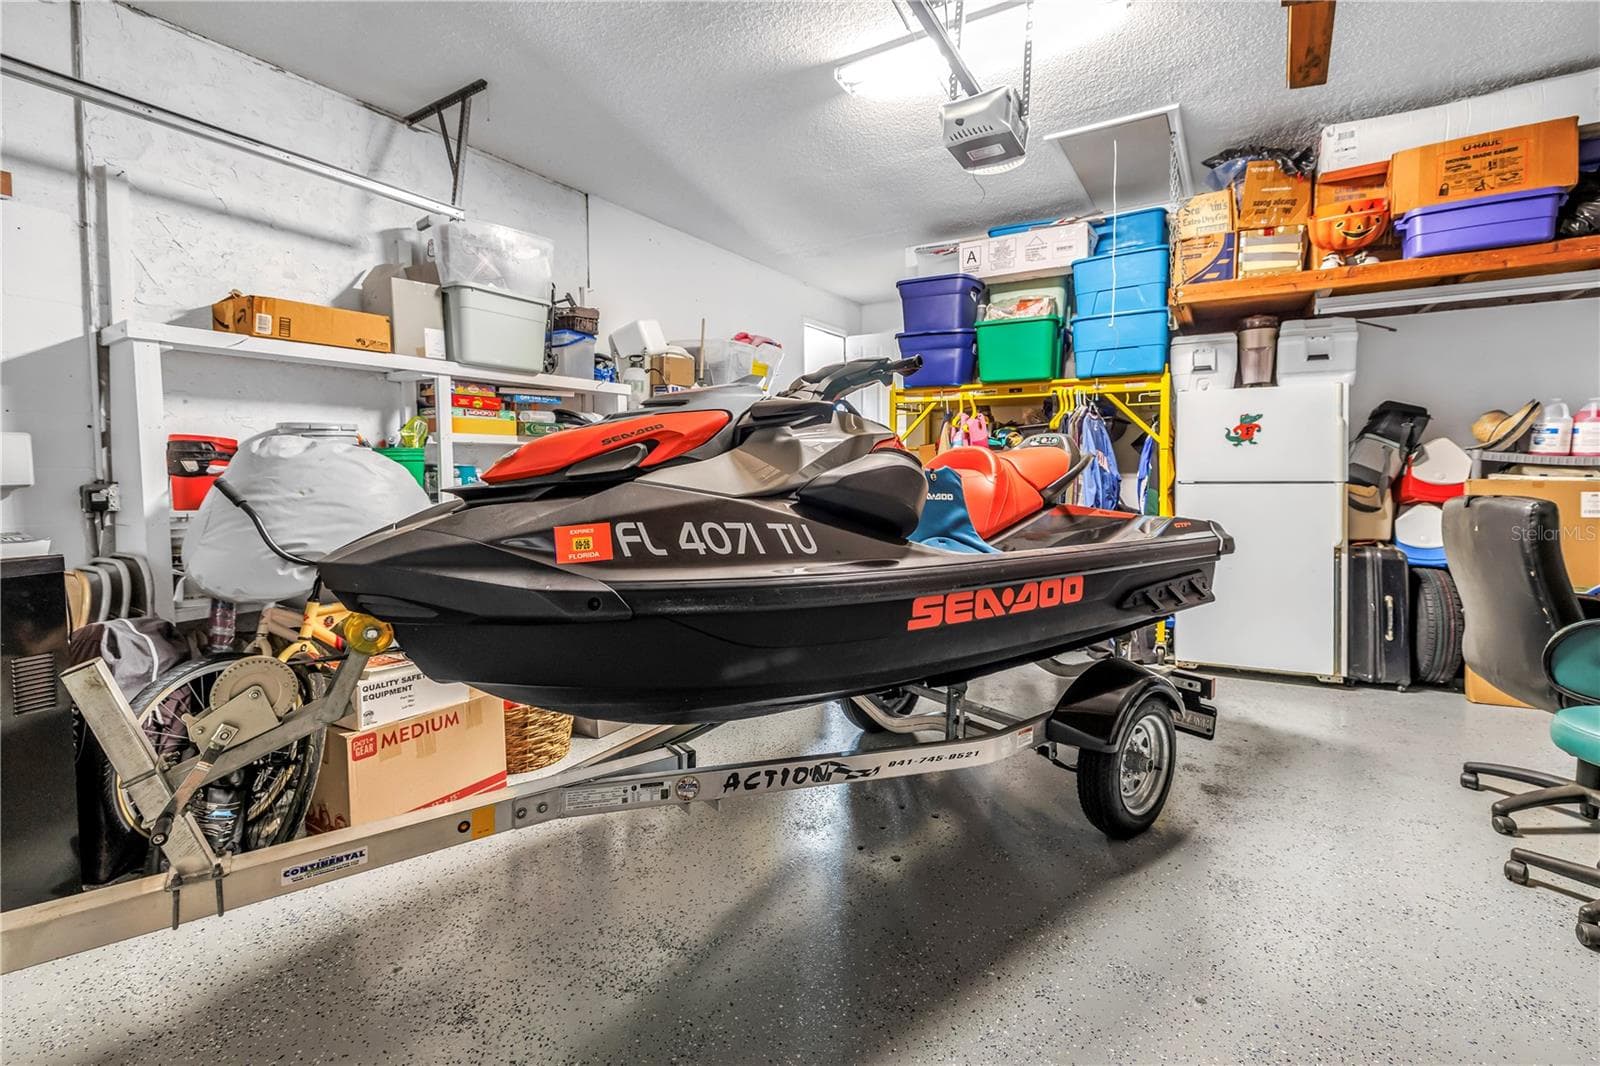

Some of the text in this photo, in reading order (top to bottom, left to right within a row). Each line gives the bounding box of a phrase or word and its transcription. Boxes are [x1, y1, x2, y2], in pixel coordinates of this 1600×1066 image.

[1463, 139, 1500, 151] U-HAUL
[966, 250, 977, 264] A
[615, 521, 818, 557] FL 4071 TU
[568, 551, 600, 560] FLORIDA
[362, 678, 399, 693] QUALITY
[362, 685, 413, 702] EQUIPMENT
[381, 711, 460, 749] MEDIUM
[355, 743, 374, 757] GEAR
[723, 764, 833, 793] ACTION
[283, 848, 366, 878] CONTINENTAL
